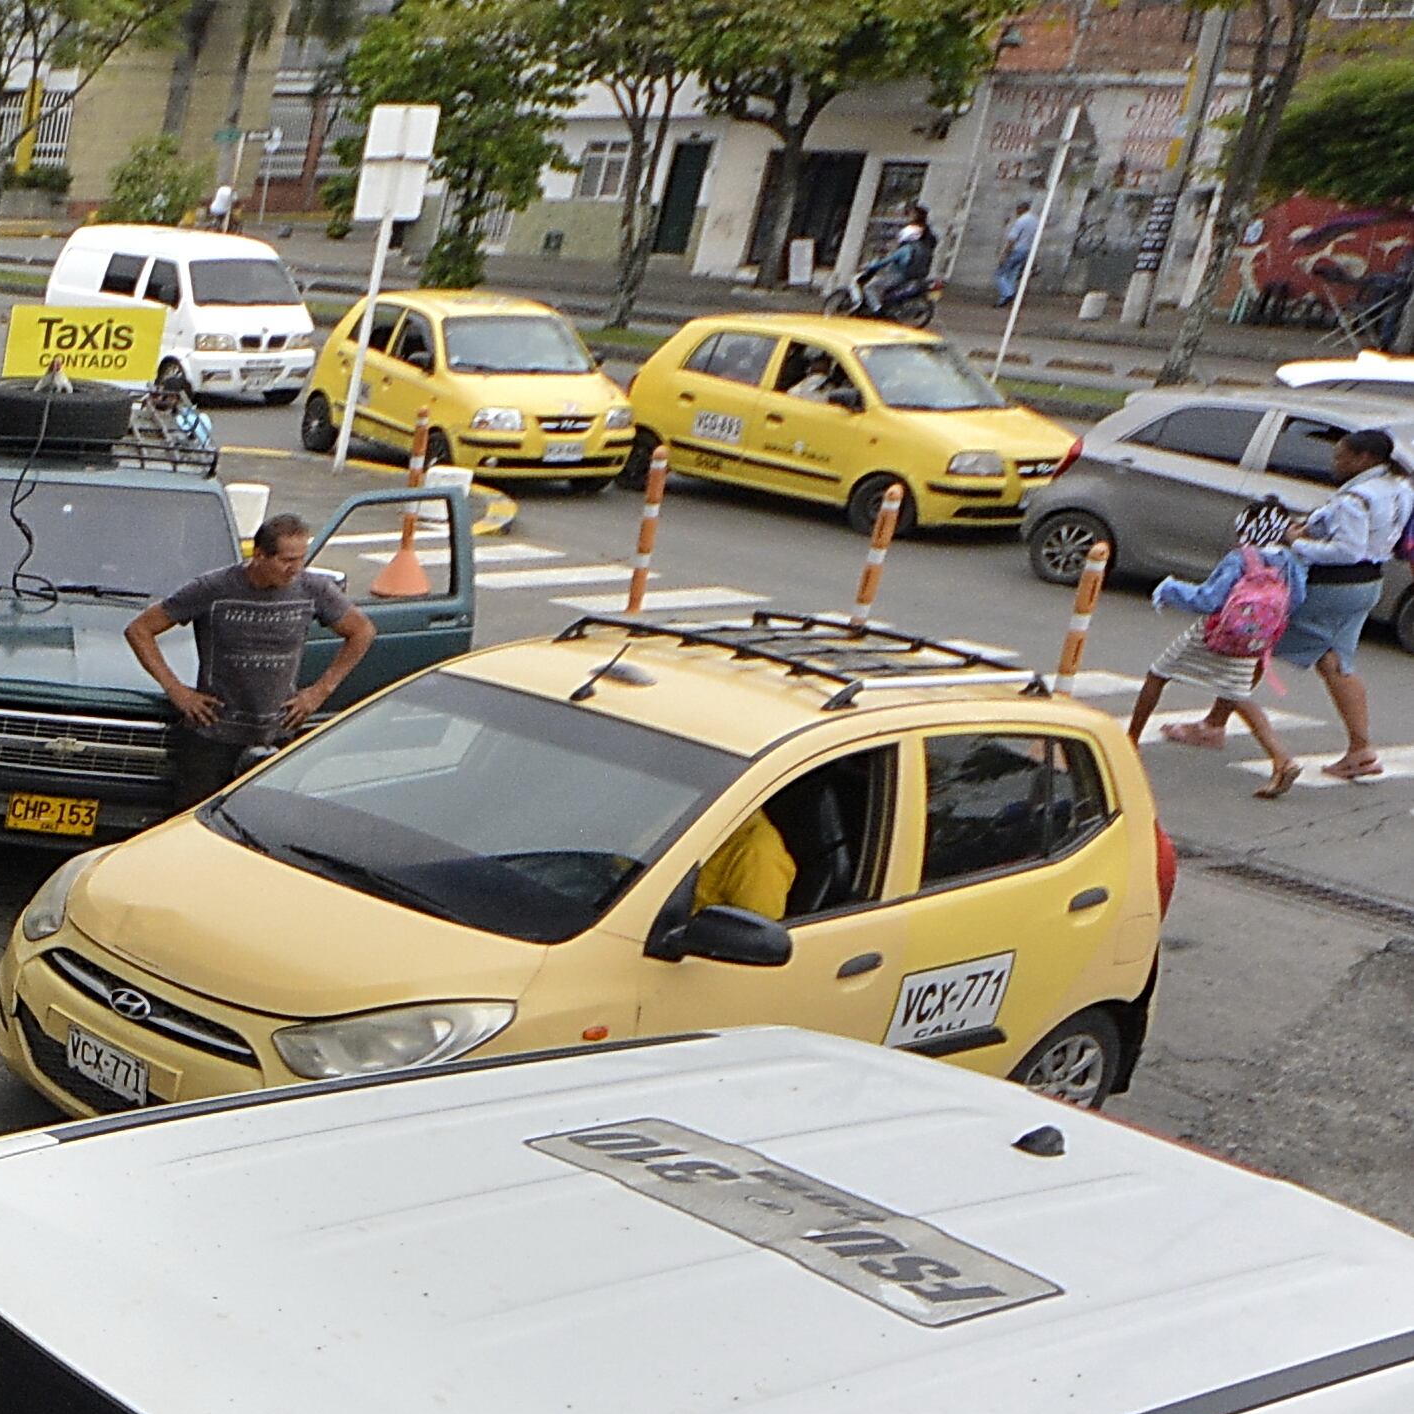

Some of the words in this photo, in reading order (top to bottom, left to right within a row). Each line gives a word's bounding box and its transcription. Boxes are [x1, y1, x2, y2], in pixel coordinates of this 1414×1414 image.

[37, 317, 135, 351] Taxis
[39, 353, 128, 370] CONTADO
[901, 969, 1007, 1027] VCX-771
[914, 1019, 967, 1039] CALI
